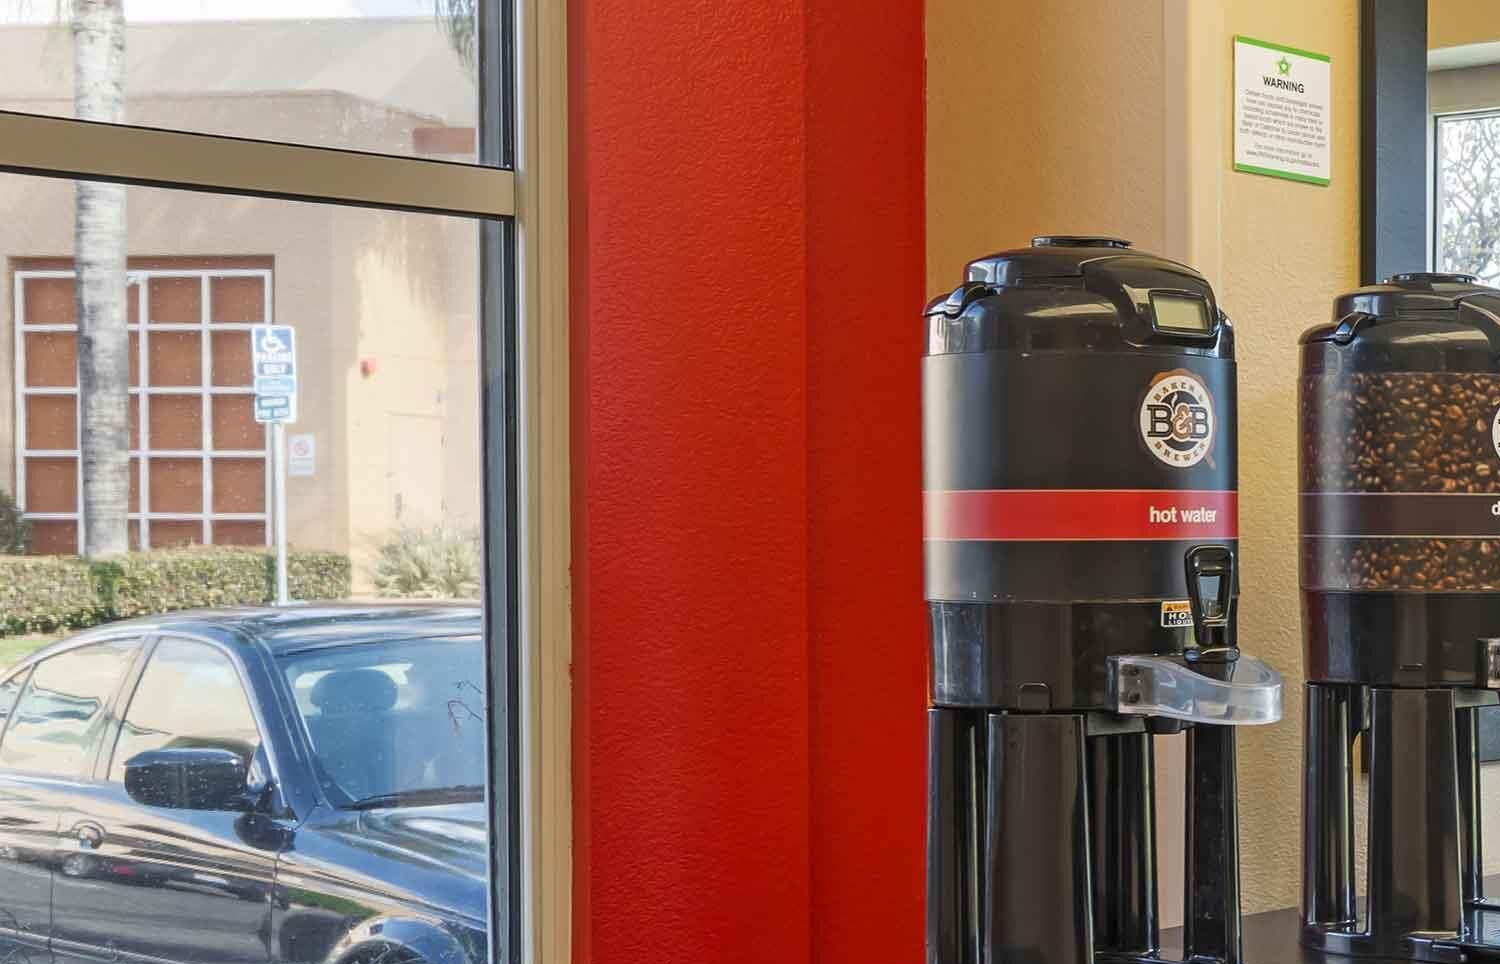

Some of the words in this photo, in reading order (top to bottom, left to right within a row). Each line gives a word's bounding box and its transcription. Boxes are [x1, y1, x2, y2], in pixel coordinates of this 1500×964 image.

[1262, 75, 1305, 94] WARNING
[1149, 506, 1178, 523] hot
[1180, 506, 1217, 523] water
